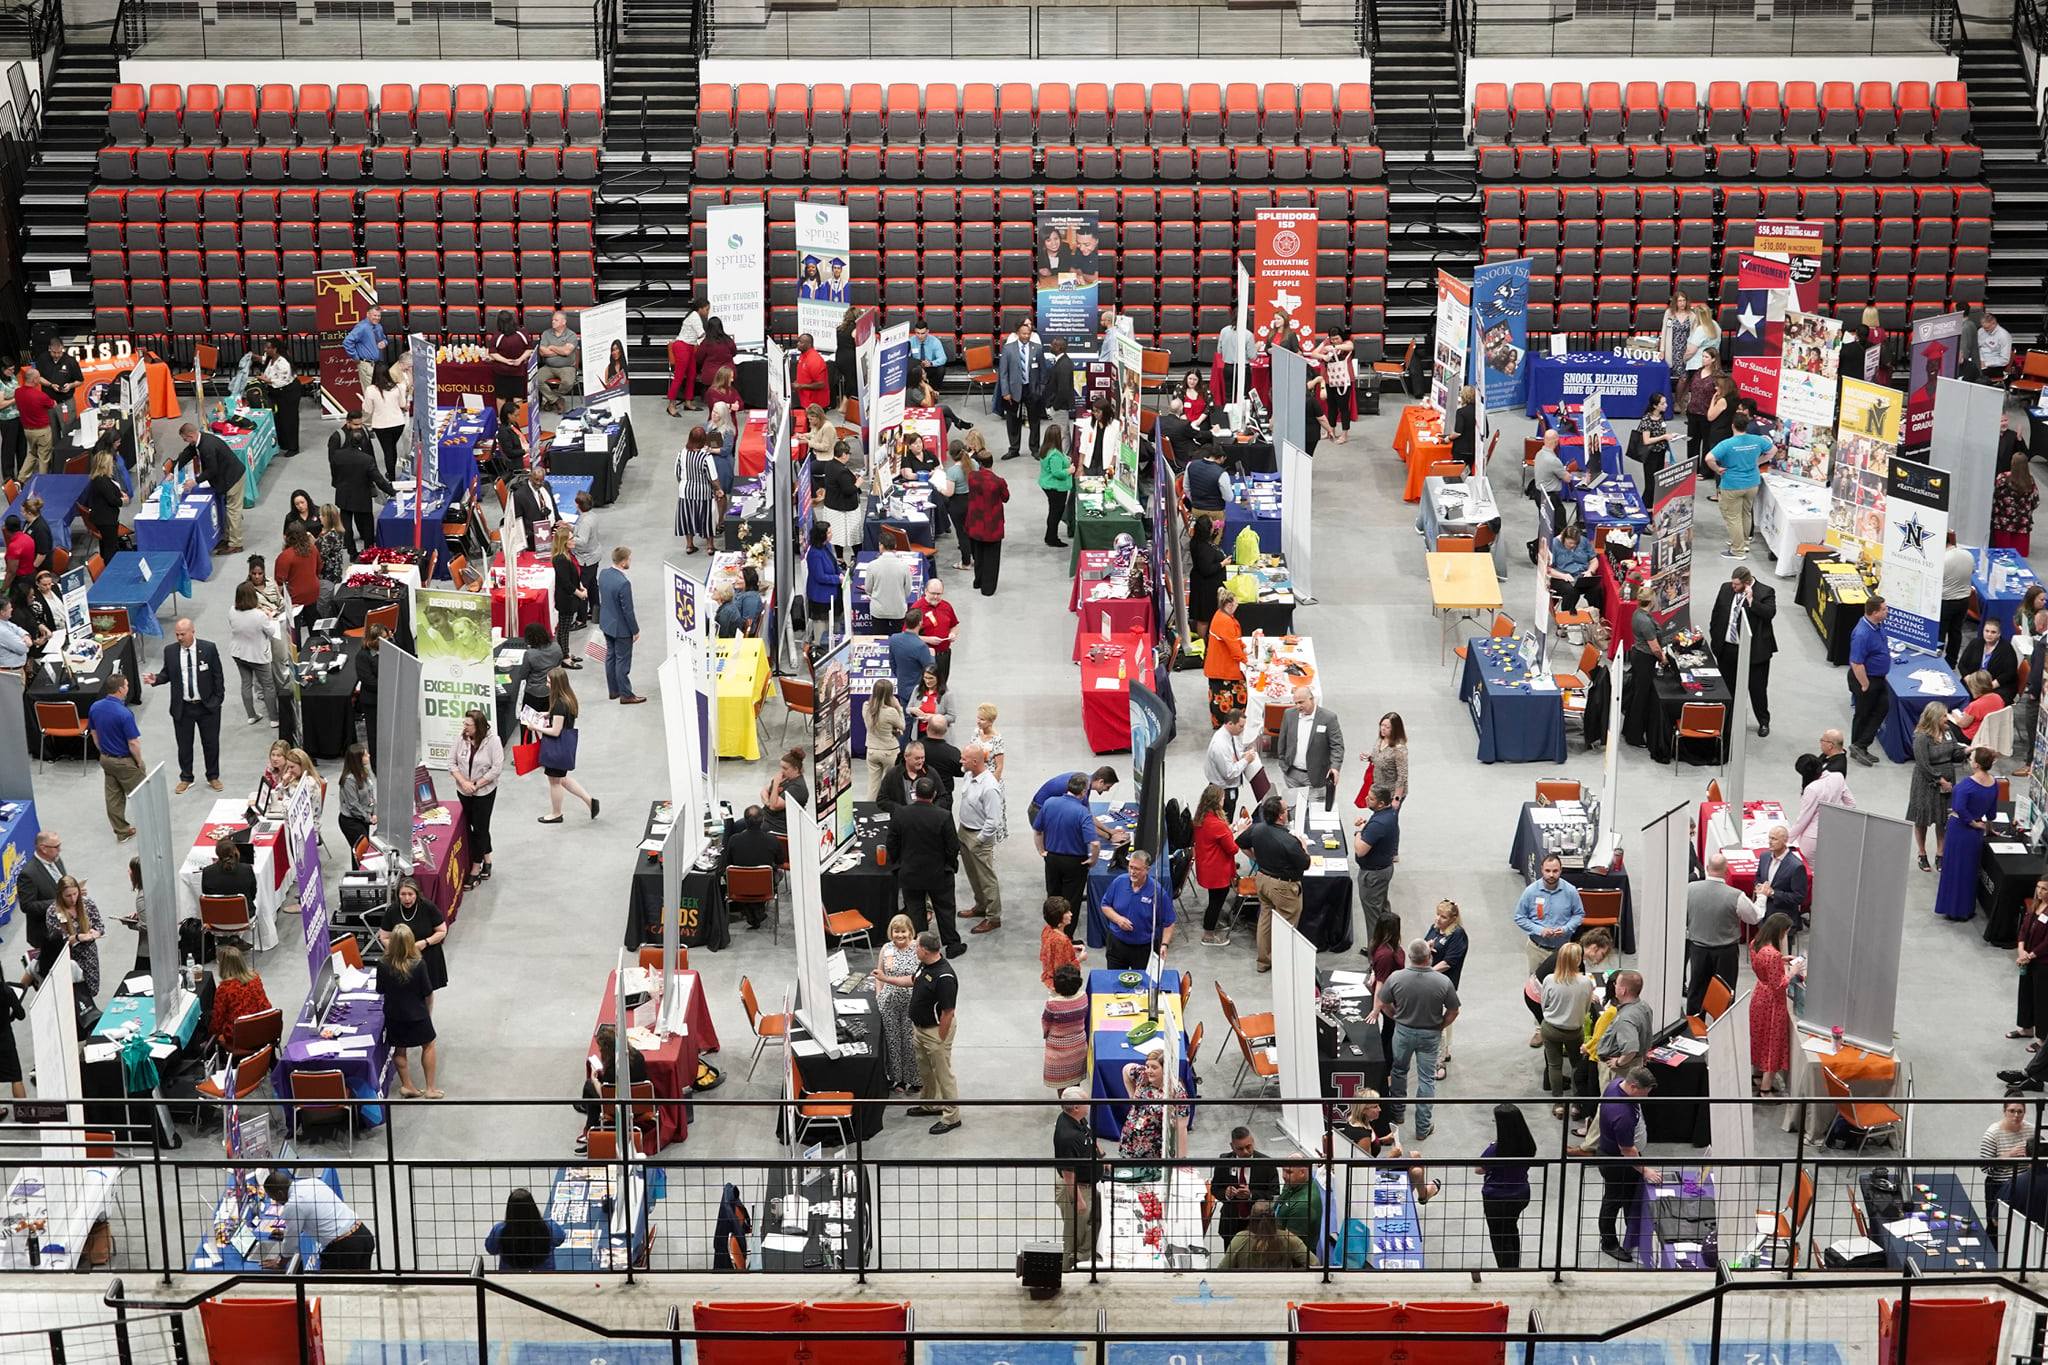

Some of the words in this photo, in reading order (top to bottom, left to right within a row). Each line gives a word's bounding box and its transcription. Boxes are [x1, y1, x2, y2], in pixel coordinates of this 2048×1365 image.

[1257, 212, 1317, 221] SPLENDORA
[1278, 221, 1296, 229] ISD
[805, 228, 840, 245] spring
[1760, 241, 1787, 252] +$10,000
[715, 252, 756, 270] spring
[1474, 265, 1512, 288] SNOOK
[1514, 265, 1531, 279] ISD
[712, 292, 732, 303] EVERY
[732, 290, 759, 301] STUDENT
[712, 302, 732, 313] EVERY
[732, 301, 759, 311] TEACHER
[802, 306, 820, 316] EVERY
[820, 308, 845, 319] STUDEN
[732, 313, 744, 322] DAY
[802, 316, 820, 328] EVERY
[320, 330, 351, 341] Tarki
[820, 330, 832, 339] DAY
[426, 345, 435, 373] ISD
[1613, 346, 1662, 363] SNOOK
[1734, 358, 1749, 370] Our
[1748, 361, 1777, 377] Standard
[334, 377, 359, 387] Longho
[1563, 372, 1594, 384] SNOOK
[1595, 373, 1638, 385] BLUEJAYS
[437, 384, 470, 393] NGTON
[1563, 386, 1584, 395] HOME
[1585, 386, 1595, 395] OF
[1740, 382, 1773, 399] Excellence
[427, 375, 438, 433] CREEK
[1911, 412, 1931, 422] DON'T
[1912, 421, 1934, 432] GRADU
[429, 434, 439, 487] CLEAR
[1905, 523, 1923, 548] N
[429, 597, 462, 609] DESOTO
[462, 599, 477, 611] ISD
[1888, 608, 1925, 625] EARNING
[1883, 618, 1931, 640] UCCEEDING
[676, 630, 698, 650] FAITH
[423, 679, 491, 698] EXCELLENCE
[425, 698, 492, 722] DESIGN
